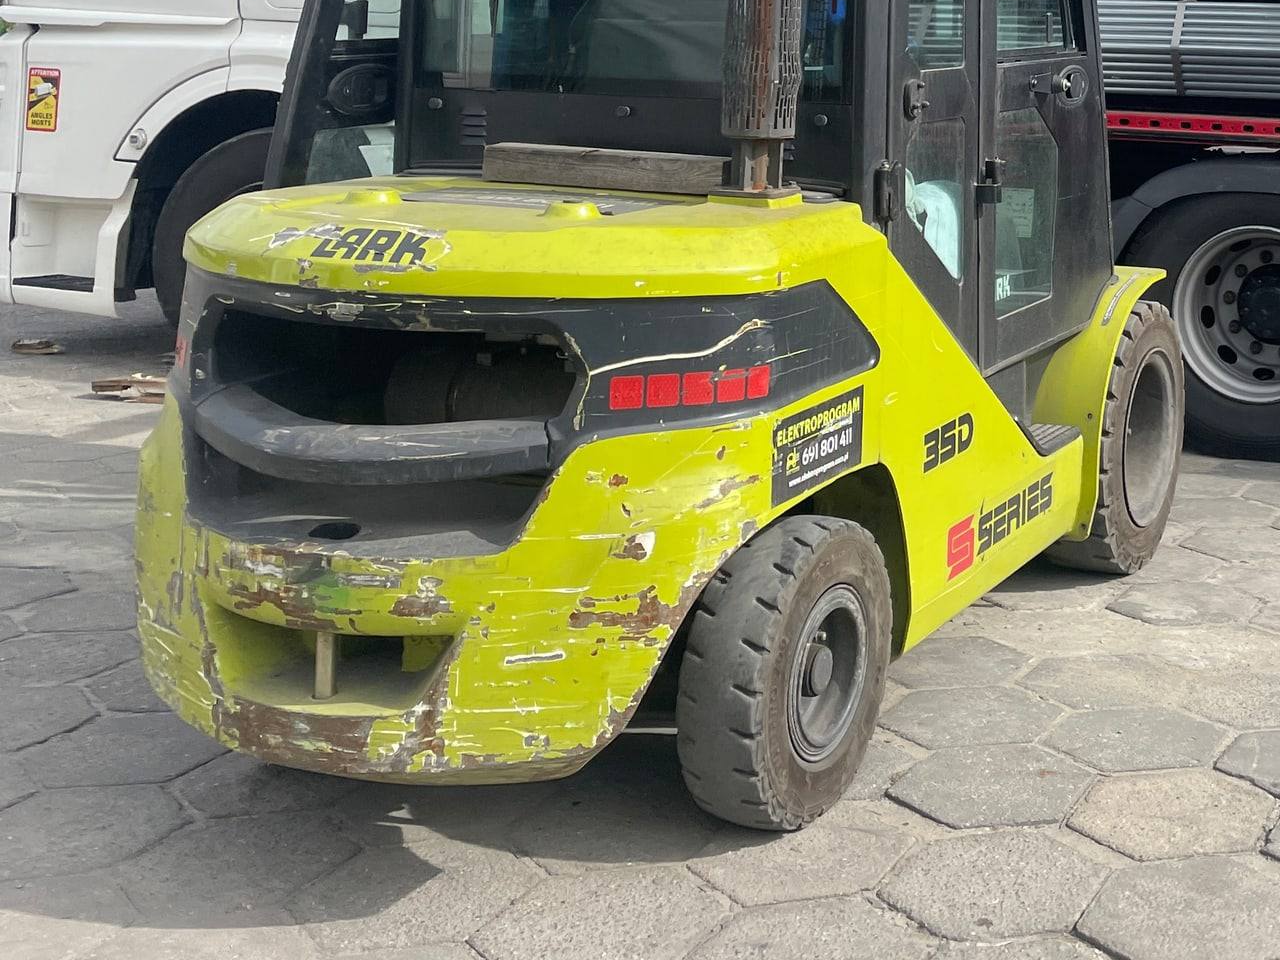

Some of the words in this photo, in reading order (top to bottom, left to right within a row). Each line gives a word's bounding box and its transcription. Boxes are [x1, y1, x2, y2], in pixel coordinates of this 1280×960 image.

[776, 396, 860, 447] ELEKTROPROGRAM
[802, 442, 819, 466] 691
[820, 434, 838, 457] 801
[839, 427, 853, 447] 411
[923, 412, 974, 474] 35D
[977, 472, 1054, 557] SERIES
